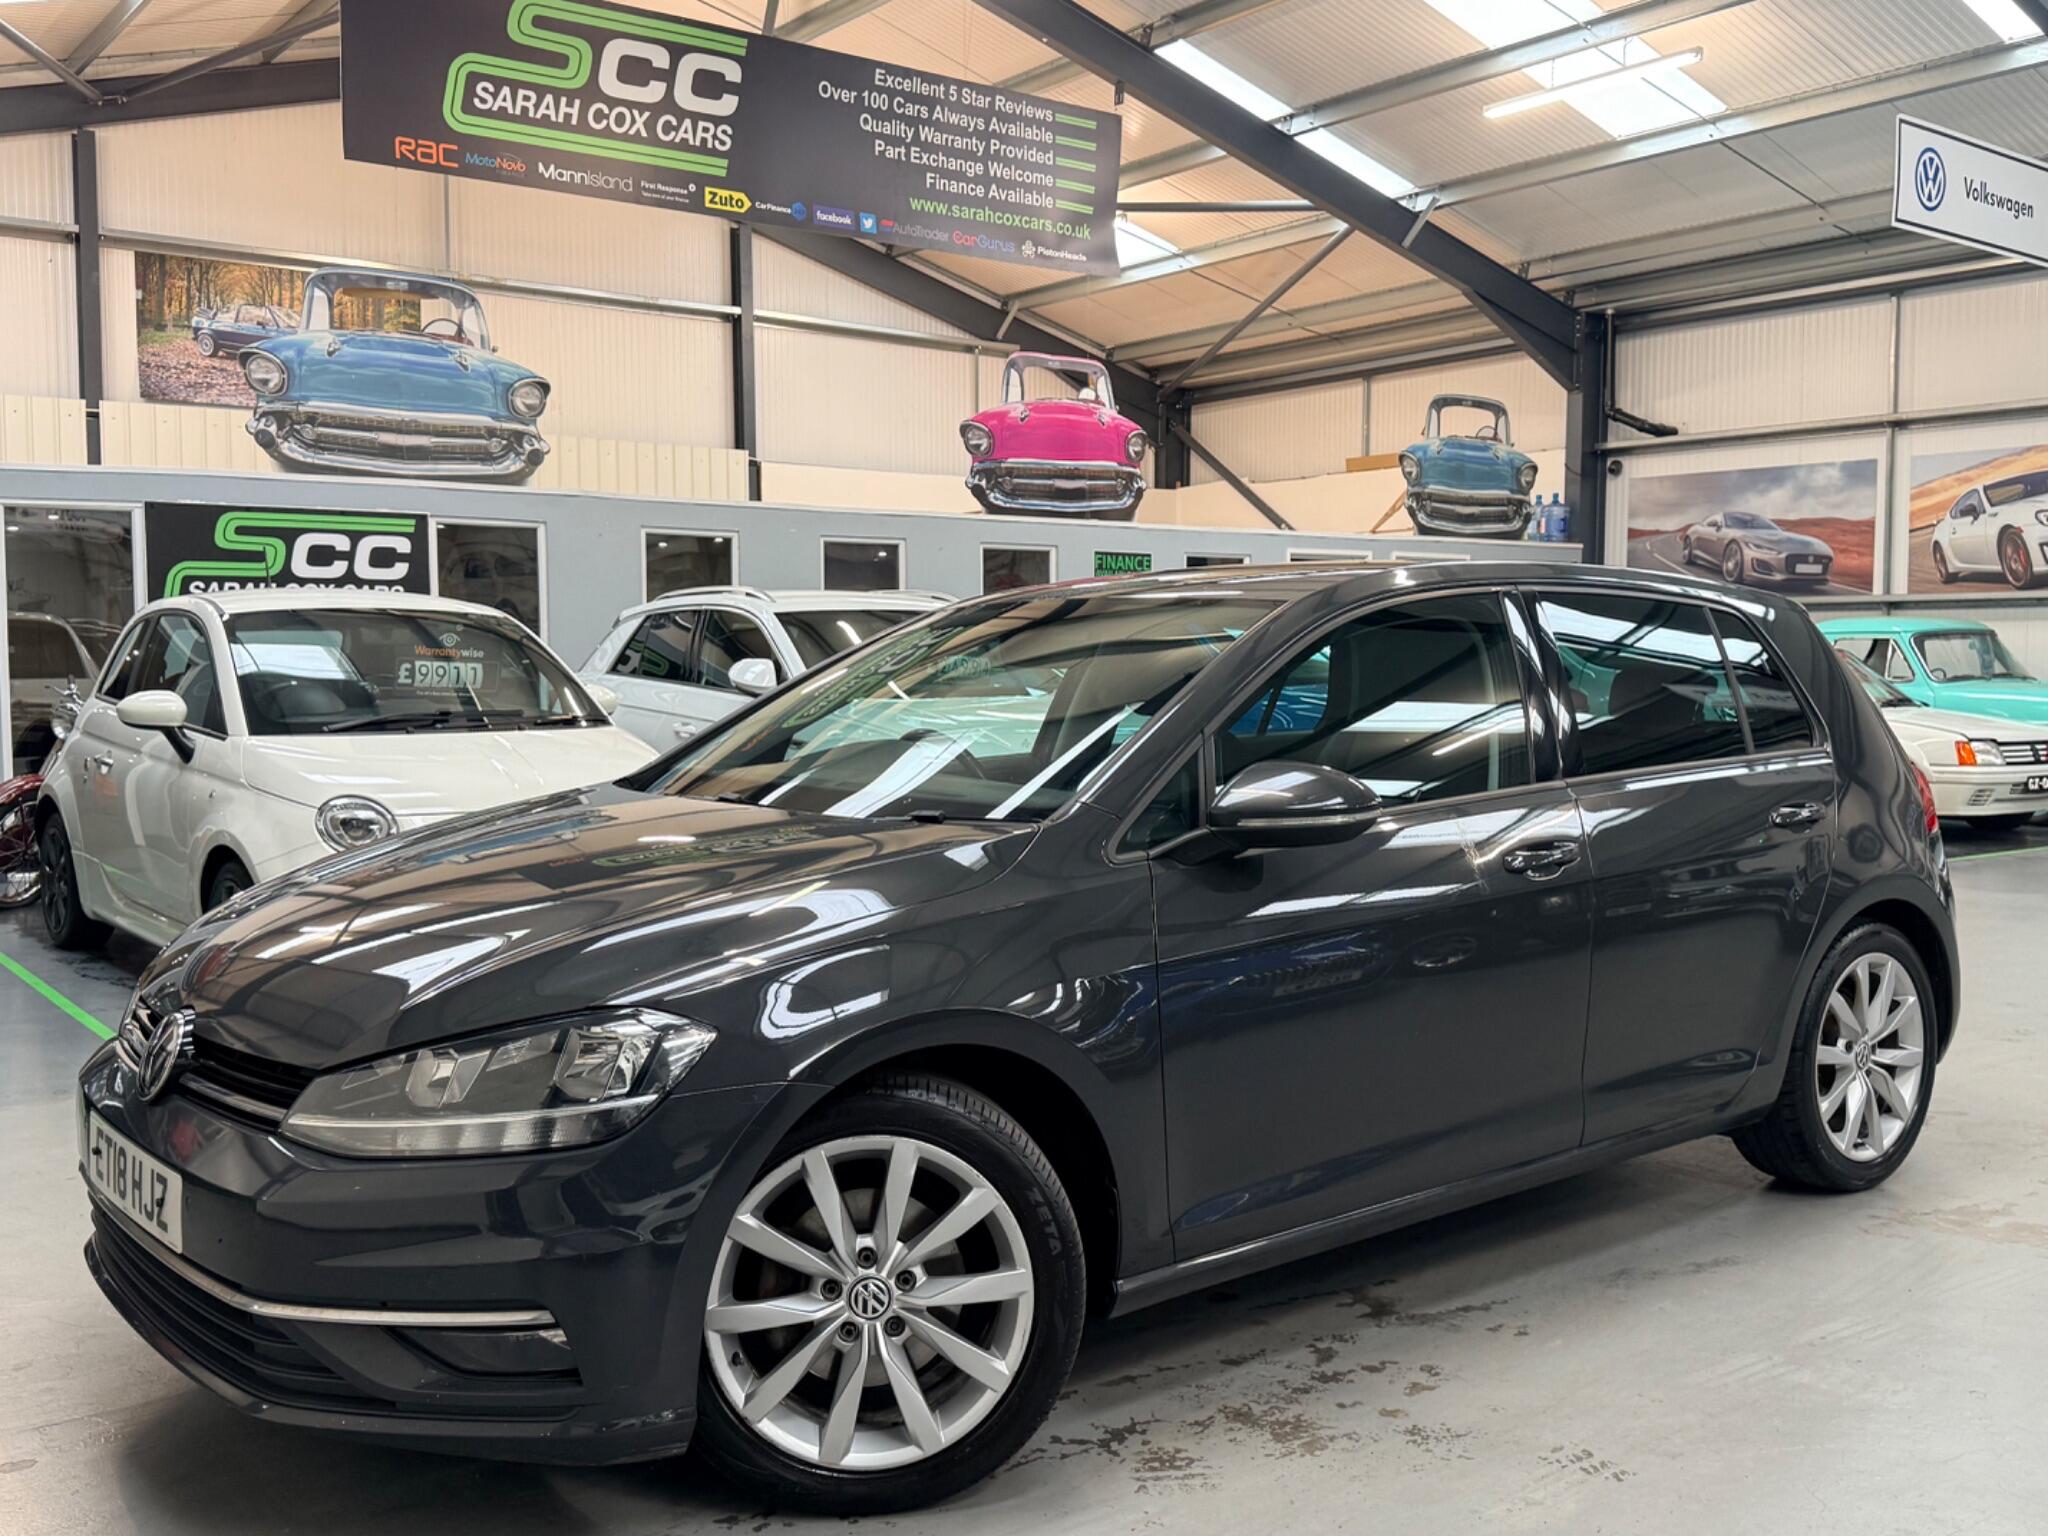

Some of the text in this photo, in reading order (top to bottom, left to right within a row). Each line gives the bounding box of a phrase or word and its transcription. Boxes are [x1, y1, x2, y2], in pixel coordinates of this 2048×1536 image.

[818, 80, 1054, 144] Over 100 Cars Always Available
[875, 68, 1054, 122] Excellent 5 Star Reviews
[473, 81, 733, 151] SARAH COX CARS
[859, 113, 1054, 166] Quality Warranty Provided
[465, 152, 526, 172] MotoNovo
[874, 139, 1054, 187] Part Exchange Welcome
[657, 182, 688, 195] Response
[708, 191, 745, 209] Zuto
[926, 172, 1054, 209] Finance Available
[1964, 176, 2034, 219] Volkswagen
[816, 211, 852, 225] facebook
[909, 197, 1091, 241] www.sarahcoxcars.co.uk
[952, 230, 1015, 252] CarGurus
[1037, 246, 1087, 262] PistonHeads
[1095, 554, 1151, 571] FINANCE
[415, 645, 484, 658] Warrantywise
[131, 1154, 169, 1233] HJZ
